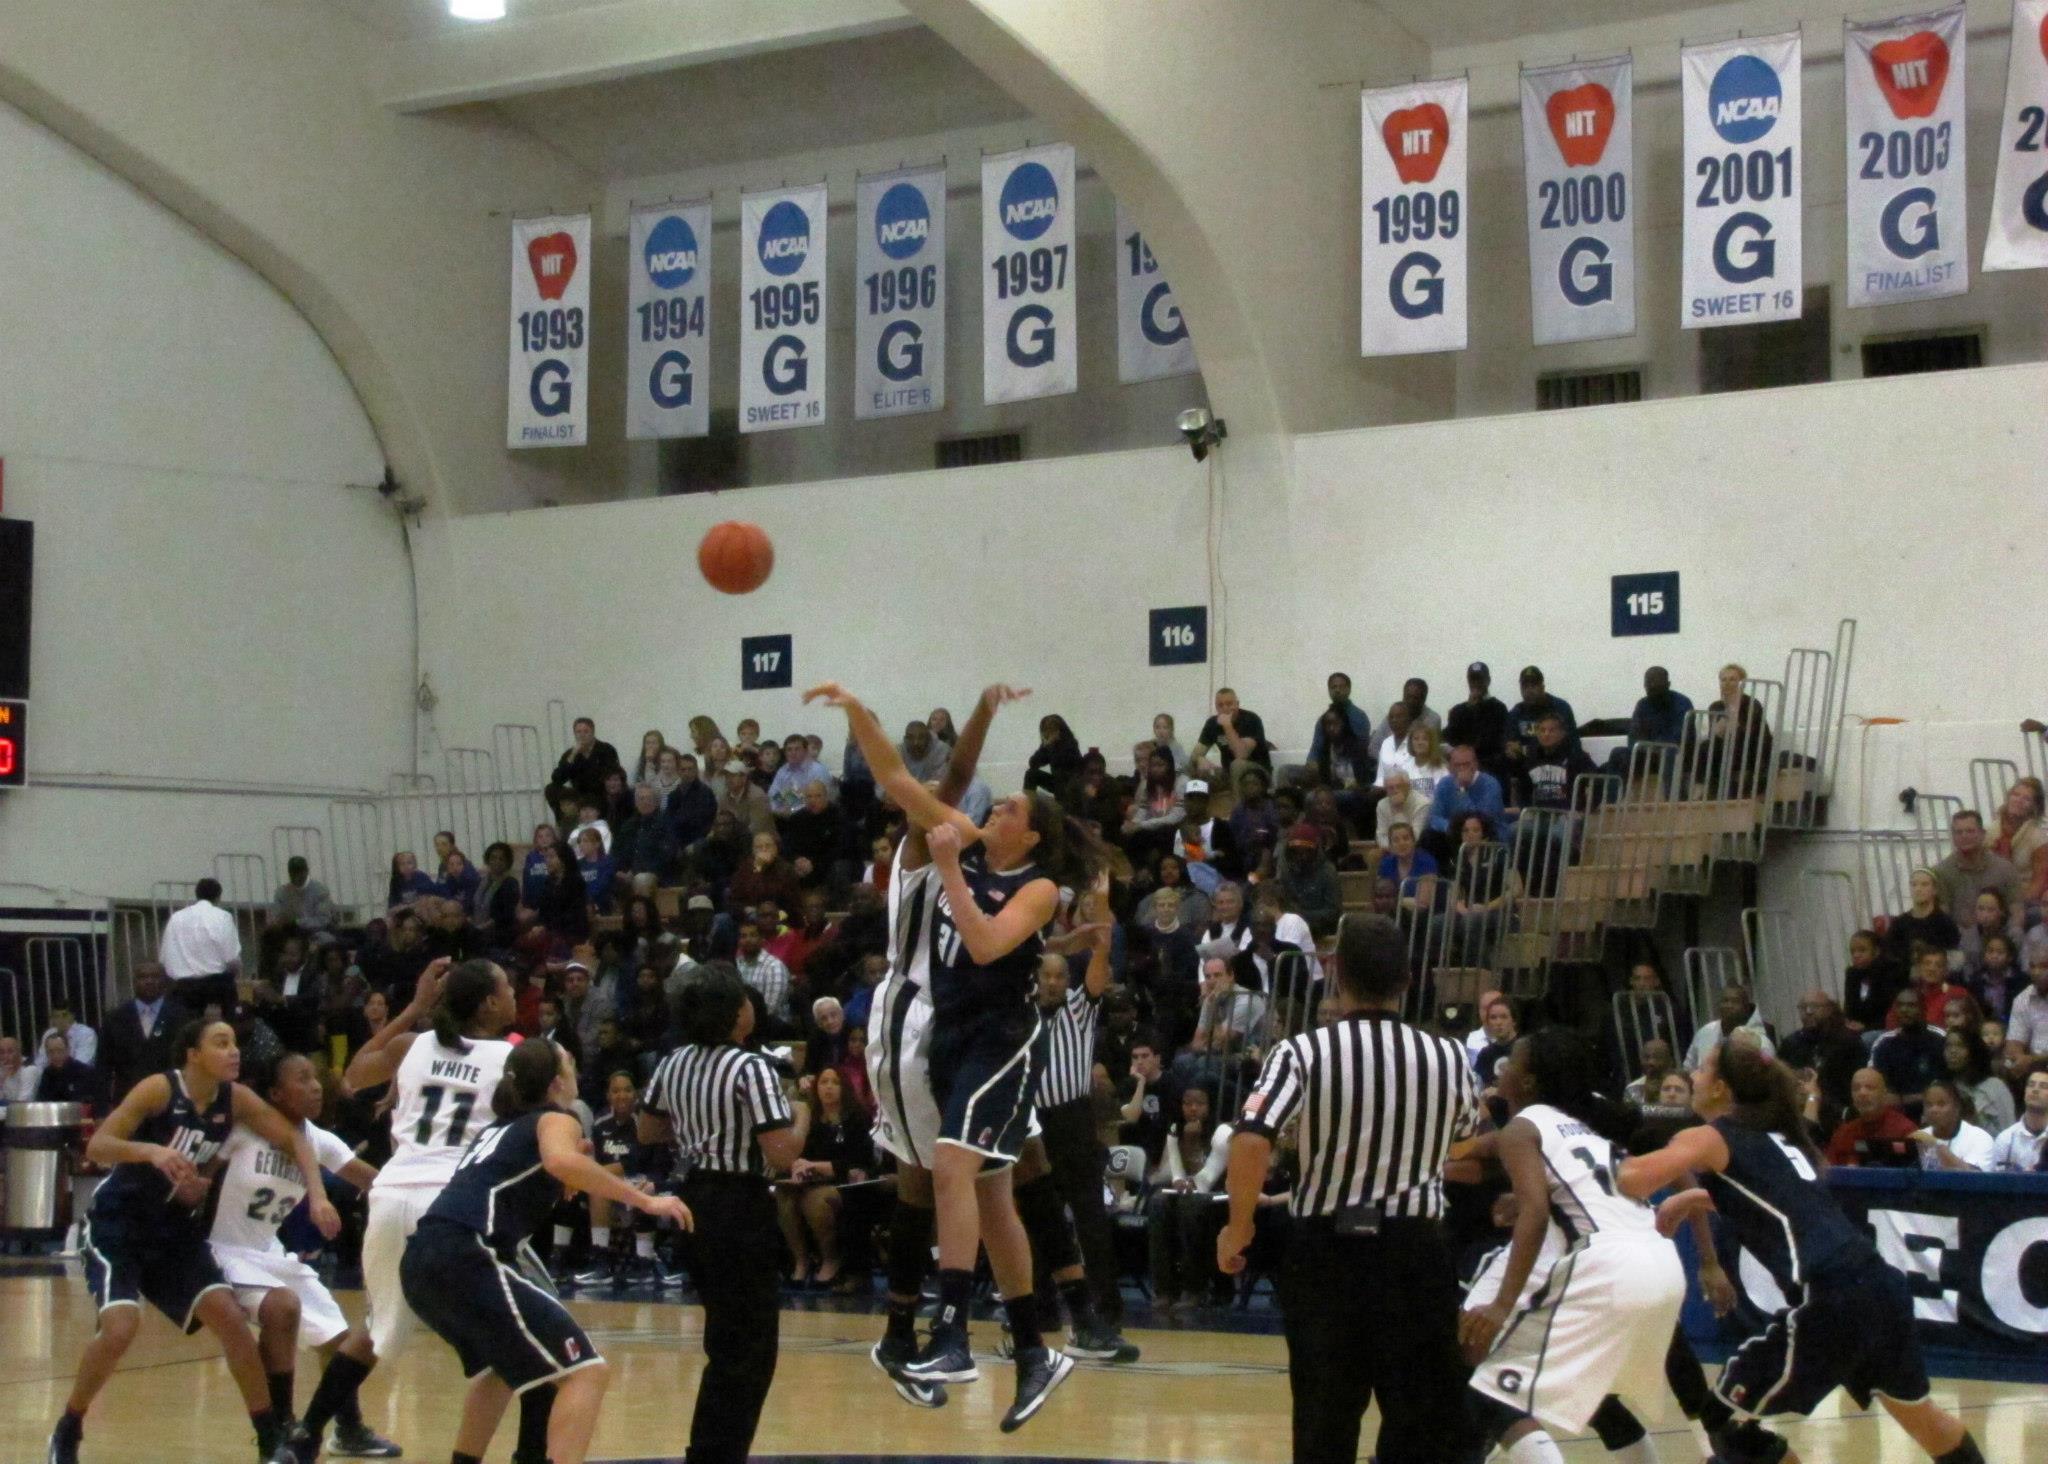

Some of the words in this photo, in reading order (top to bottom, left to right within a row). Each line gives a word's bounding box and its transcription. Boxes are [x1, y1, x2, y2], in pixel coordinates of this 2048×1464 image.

[1892, 59, 1929, 89] NIT
[1564, 110, 1597, 138] NIT
[1716, 96, 1779, 126] NCAA
[2014, 105, 2048, 151] 2
[1402, 129, 1433, 156] NIT
[1859, 121, 1951, 180] 2003
[1696, 146, 1793, 208] 2001
[1006, 197, 1056, 224] NCAA
[1372, 190, 1460, 244] 1999
[1538, 172, 1626, 229] 2000
[1880, 187, 1940, 260] G
[763, 236, 809, 260] NCAA
[881, 219, 929, 244] NCAA
[1712, 211, 1776, 284] G
[650, 250, 696, 273] NCAA
[992, 244, 1069, 299] 1997
[1558, 236, 1613, 306] G
[1865, 261, 1955, 291] FINALIST
[750, 281, 820, 331] 1995
[865, 264, 937, 315] 1996
[1389, 251, 1445, 320] G
[1692, 292, 1766, 319] SWEET
[1772, 290, 1794, 310] 16
[518, 307, 584, 352] 1993
[637, 296, 705, 342] 1994
[1006, 304, 1056, 368] G
[1141, 281, 1190, 346] G
[762, 334, 808, 396] G
[877, 319, 924, 381] G
[530, 359, 572, 417] G
[649, 350, 693, 409] G
[874, 389, 918, 409] ELITE
[522, 424, 577, 440] FINALIST
[747, 402, 801, 423] SWEET
[806, 400, 820, 418] 16
[1626, 591, 1665, 616] 115
[1161, 625, 1195, 649] 116
[752, 652, 781, 674] 117
[431, 1060, 481, 1084] WHITE
[415, 1085, 478, 1146] 11
